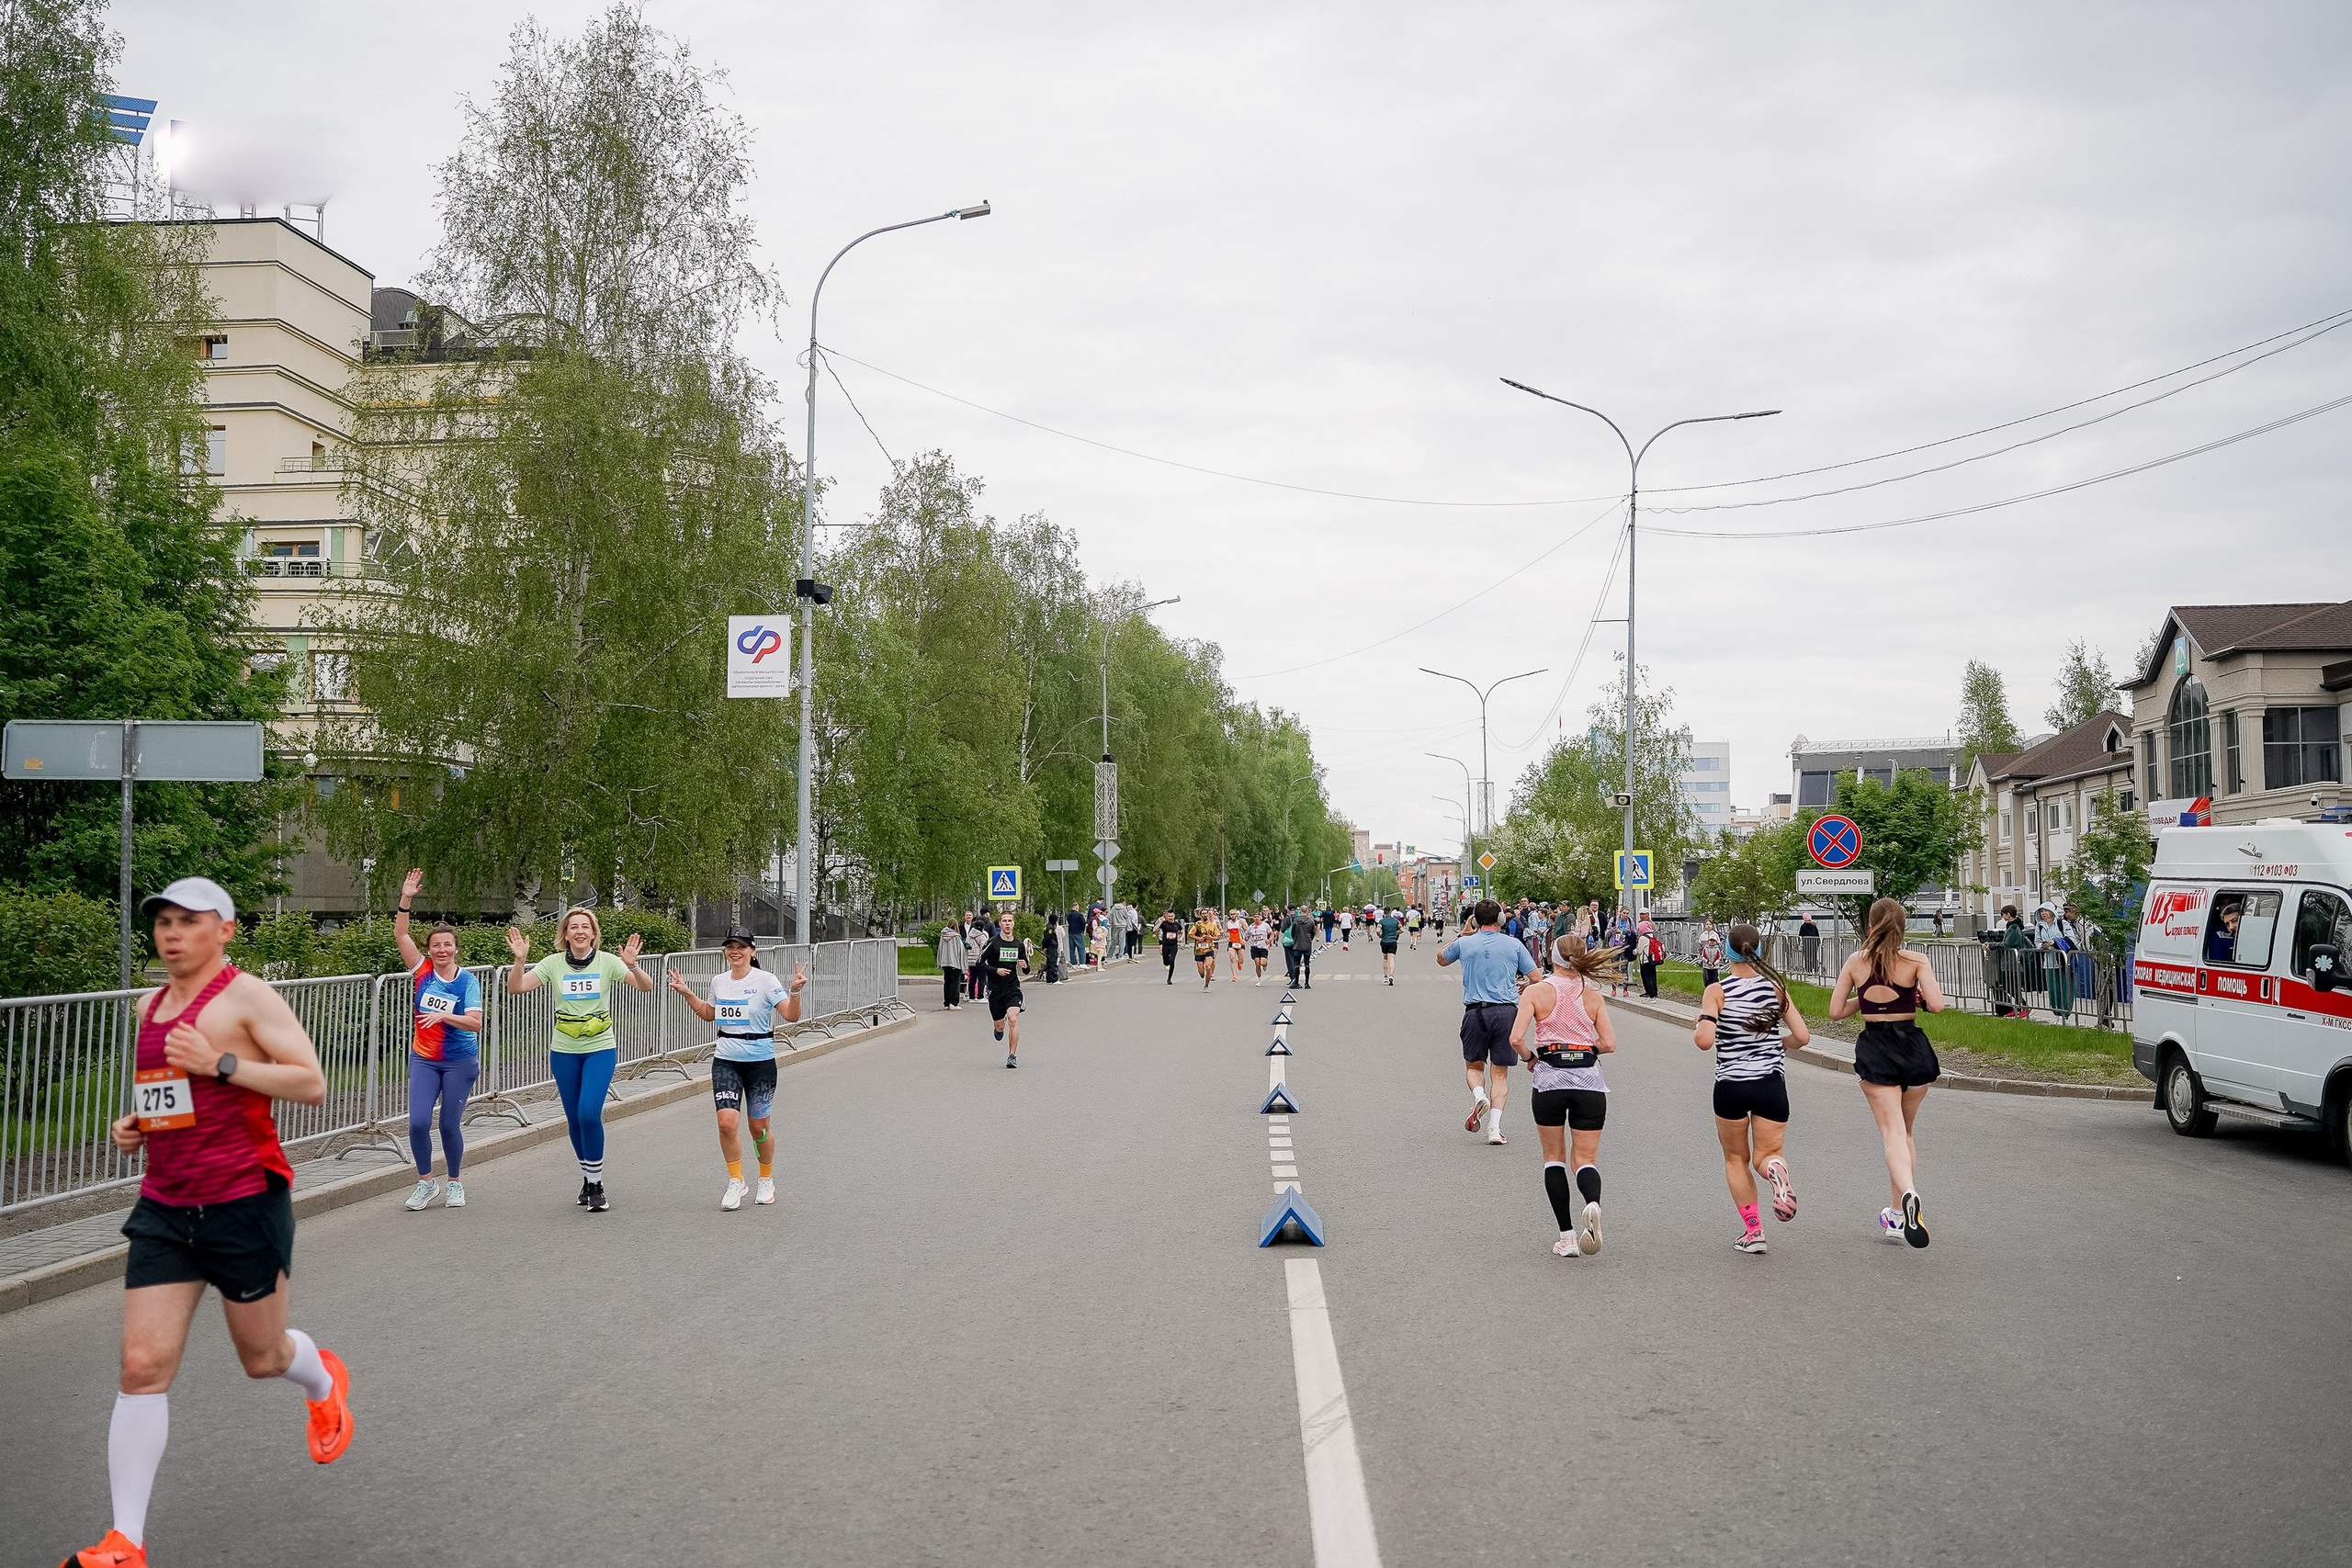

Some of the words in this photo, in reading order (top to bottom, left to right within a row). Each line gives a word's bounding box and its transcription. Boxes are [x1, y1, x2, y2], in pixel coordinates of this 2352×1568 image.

[2153, 816, 2177, 826] ПОБЕДЫ!
[2253, 864, 2265, 876] 112
[2271, 864, 2282, 876] 103
[2288, 864, 2298, 876] 03
[571, 980, 593, 992] 515
[2134, 965, 2153, 982] СКОРАЯ
[2154, 968, 2195, 987] МЕДИЦИНСКАЯ
[2217, 976, 2247, 997] ПОМОЩЬ
[427, 997, 447, 1011] 802
[720, 1007, 741, 1018] 806
[142, 1086, 175, 1111] 275
